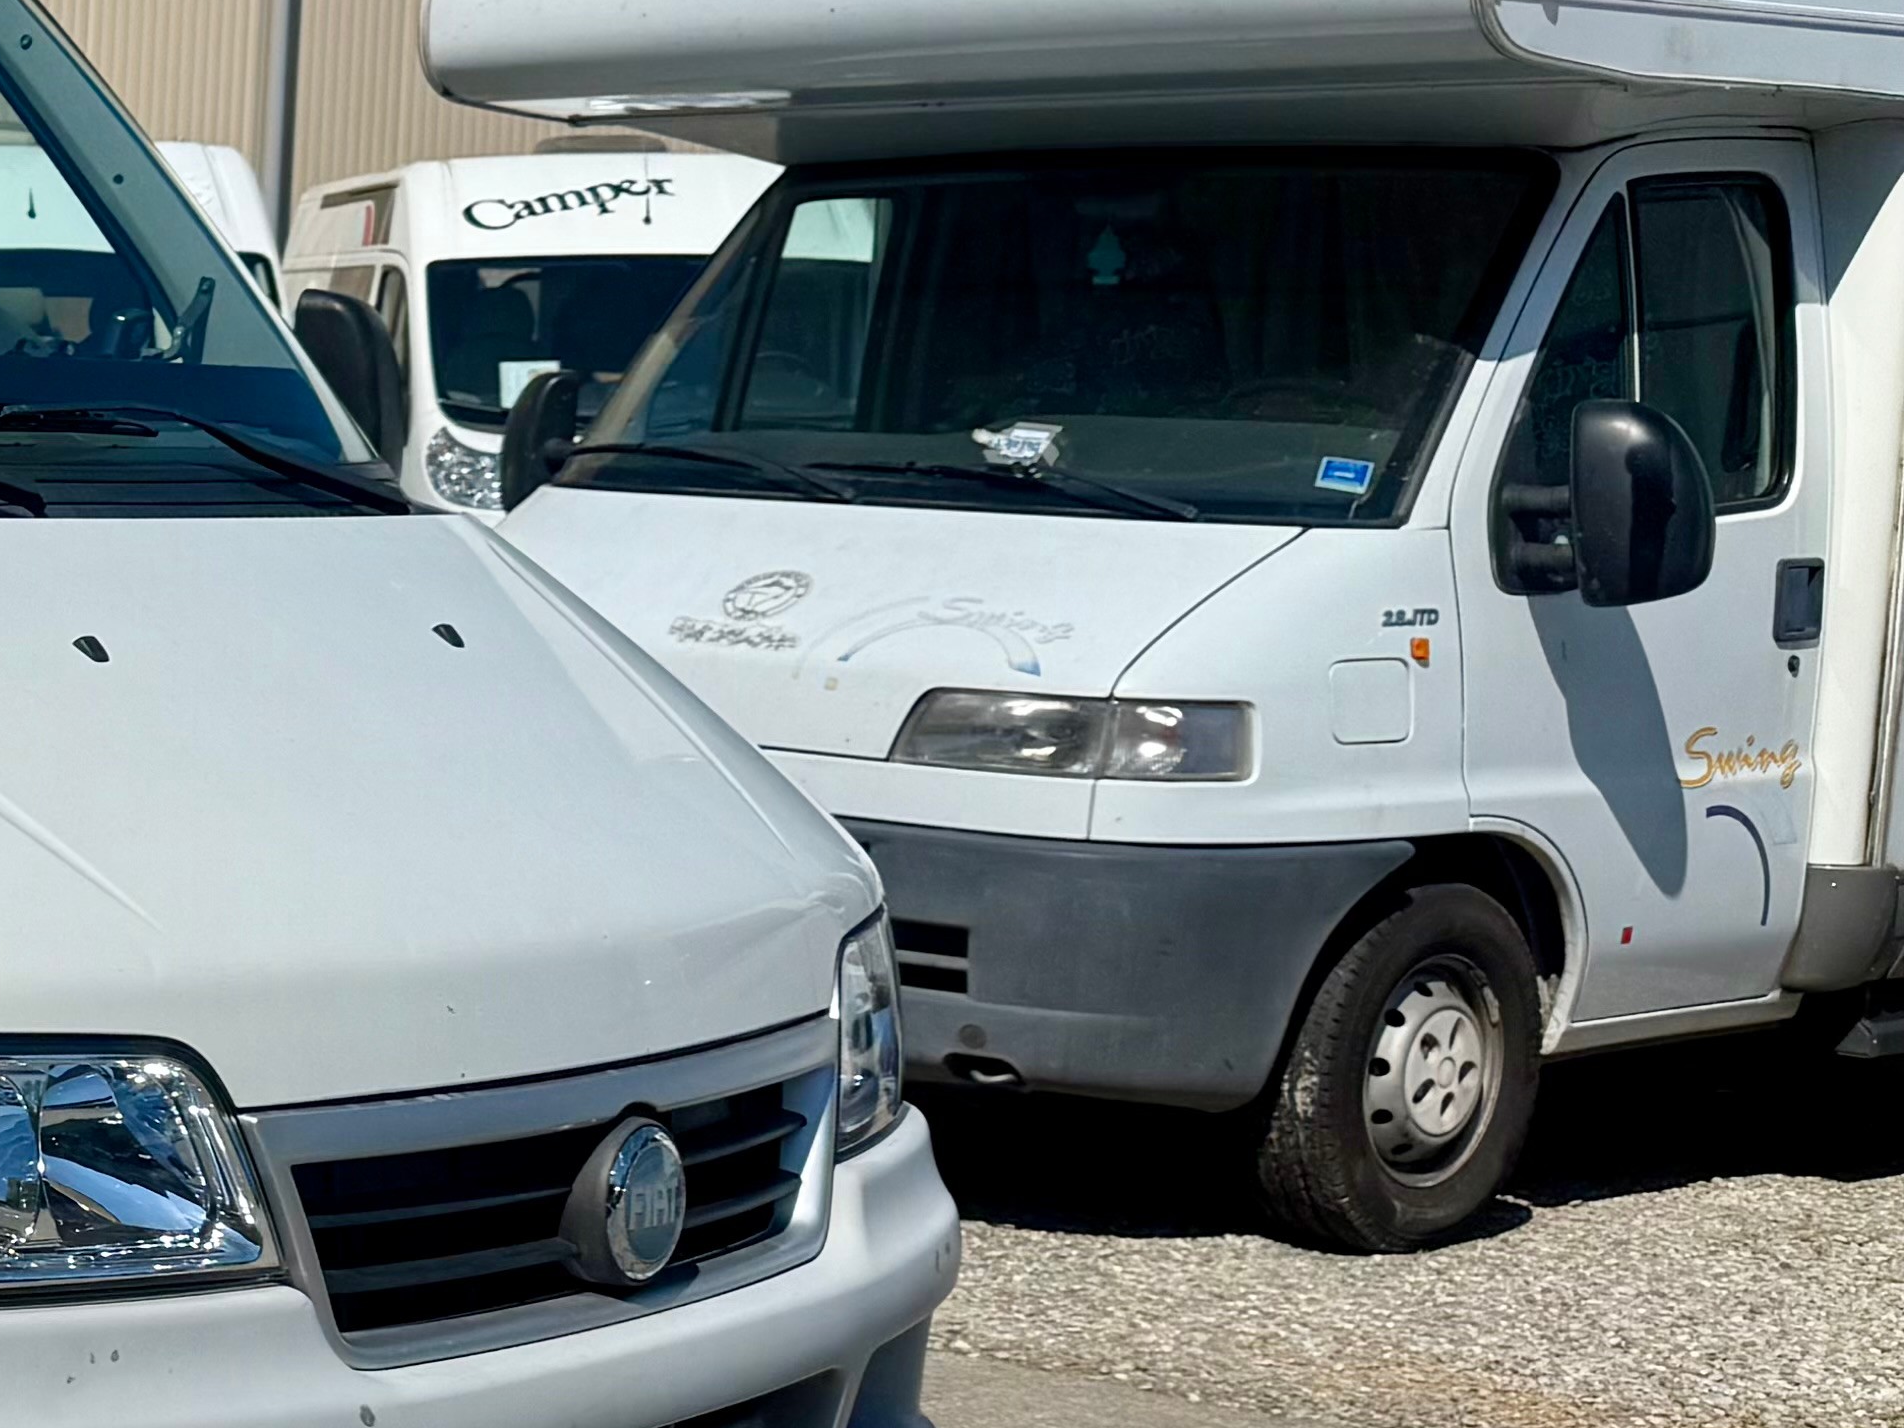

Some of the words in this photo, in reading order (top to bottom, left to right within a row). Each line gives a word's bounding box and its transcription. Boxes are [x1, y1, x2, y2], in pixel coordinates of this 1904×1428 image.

[462, 176, 674, 230] Camper
[1680, 726, 1802, 789] Swing
[629, 1177, 679, 1230] FIAT
